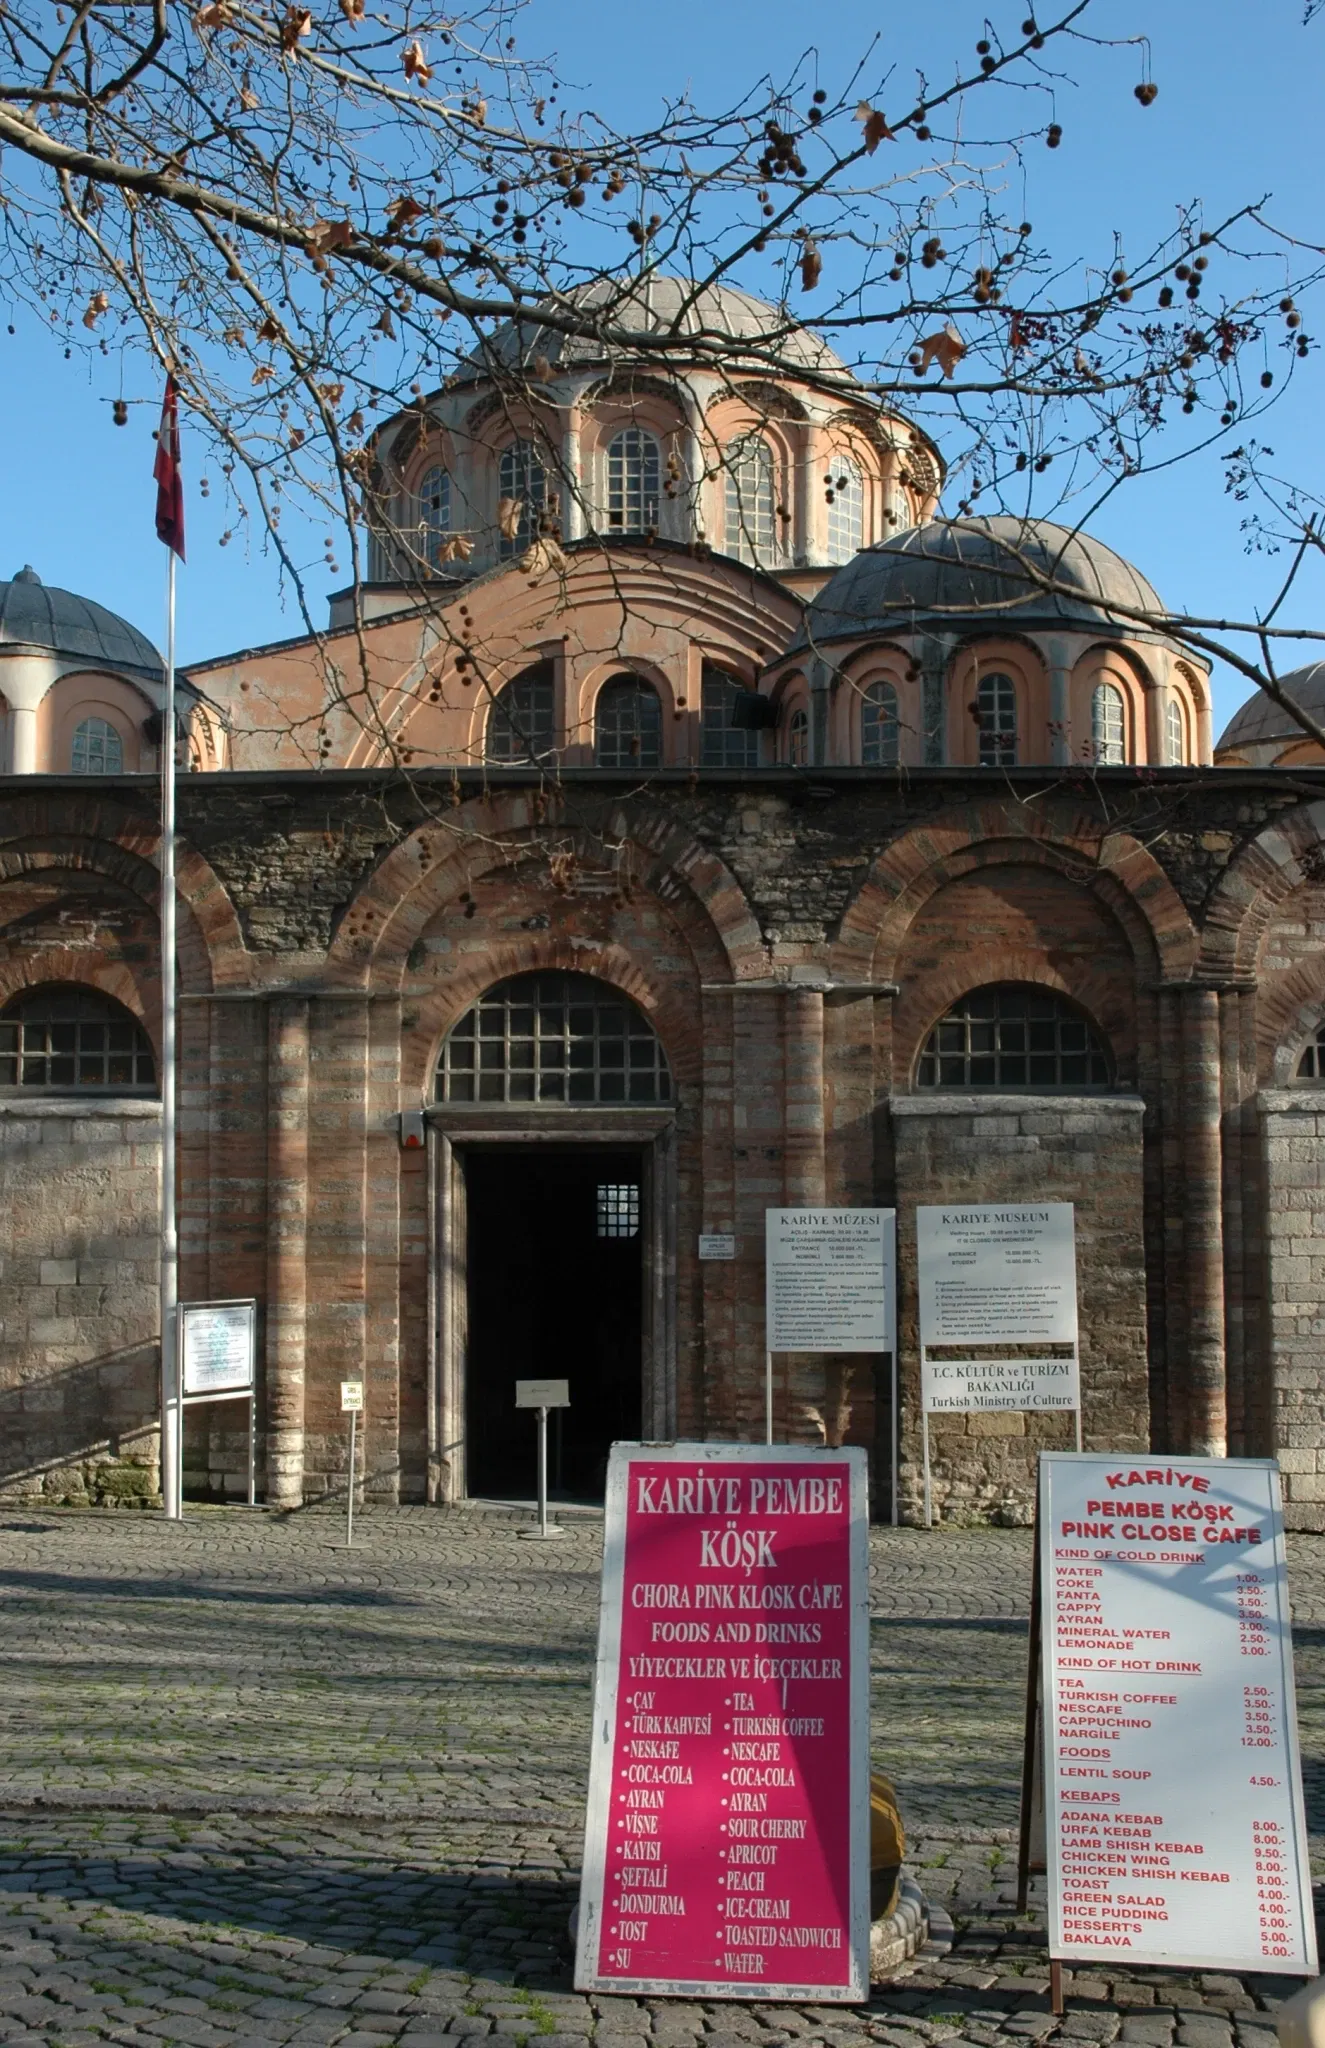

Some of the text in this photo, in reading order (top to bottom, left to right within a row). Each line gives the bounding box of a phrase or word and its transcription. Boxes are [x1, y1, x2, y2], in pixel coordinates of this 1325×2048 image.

[780, 1215, 880, 1225] KARİYE MÜZESİ
[942, 1212, 1049, 1224] KARIYE MUSEUM
[932, 1367, 953, 1378] T.C.
[957, 1364, 1004, 1377] KÜLTÜR
[1022, 1363, 1069, 1376] TURİZM
[967, 1379, 1034, 1392] BAKANLIĞI
[931, 1394, 1072, 1408] Turkish Ministry of Culture
[1105, 1467, 1211, 1493] KARİYE
[636, 1469, 842, 1514] KARİYE PEMBE
[1087, 1500, 1234, 1525] PEMBE KÖŞK
[1061, 1522, 1262, 1544] PINK CLOSE CAFE
[699, 1521, 777, 1576] KÖŞK
[1055, 1549, 1205, 1562] KIND OF COLD DRINK
[1056, 1567, 1103, 1577] WATER
[1056, 1579, 1094, 1588] COKE
[1237, 1586, 1267, 1595] 3.50.-
[632, 1585, 690, 1608] CHORA
[695, 1585, 734, 1608] PINK
[799, 1585, 842, 1609] CAFE
[1057, 1591, 1100, 1600] FANTA
[1238, 1598, 1268, 1607] 3.50.-
[1057, 1603, 1101, 1612] CAPPY
[1057, 1615, 1103, 1624] AYRAN
[652, 1623, 821, 1643] FOODS AND DRINKS
[1057, 1627, 1170, 1639] MINERAL WATER
[1058, 1639, 1134, 1650] LEMONADE
[629, 1654, 726, 1678] YİYECEKLER
[731, 1659, 750, 1678] VE
[1058, 1658, 1202, 1672] KIND OF HOT DRINK
[1058, 1679, 1084, 1688] TEA
[634, 1692, 655, 1713] ÇAY
[733, 1693, 754, 1711] TEA
[1058, 1691, 1177, 1704] TURKISH COFFEE
[1059, 1704, 1122, 1714] NESCAFE
[632, 1713, 711, 1735] TÜRK KAHVESİ
[732, 1718, 824, 1737] TURKISH COFFEE
[1059, 1716, 1152, 1729] CAPPUCHINO
[1059, 1728, 1120, 1740] NARGİLE
[630, 1741, 679, 1759] NESKAFE
[731, 1742, 780, 1761] NESCAFE
[1059, 1747, 1111, 1759] FOODS
[628, 1764, 693, 1784] COCA-COLA
[730, 1768, 795, 1787] COCA-COLA
[1060, 1767, 1152, 1780] LENTIL SOUP
[626, 1790, 664, 1809] AYRAN
[729, 1793, 766, 1812] AYRAN
[1060, 1790, 1120, 1802] KEBAPS
[625, 1811, 658, 1838] VİŞNE
[1061, 1812, 1163, 1825] ADANA KEBAB
[729, 1819, 807, 1839] SOUR CHERRY
[1061, 1825, 1152, 1837] URFA KEBAB
[623, 1841, 661, 1861] KAYISI
[1061, 1838, 1204, 1854] LAMB SHISH KEBAB
[727, 1845, 777, 1864] APRICOT
[1061, 1852, 1170, 1866] CHICKEN WING
[621, 1864, 667, 1891] ŞEFTALİ
[727, 1872, 765, 1891] PEACH
[1062, 1865, 1230, 1883] CHICKEN SHISH KEBAB
[1062, 1879, 1110, 1890] TOAST
[620, 1894, 685, 1916] DONDURMA
[1063, 1892, 1165, 1906] GREEN SALAD
[725, 1898, 790, 1919] ICE-CREAM
[1063, 1906, 1168, 1921] RICE PUDDING
[618, 1921, 648, 1941] TOST
[1064, 1919, 1142, 1933] DESSERT'S
[725, 1925, 841, 1948] TOASTED SANDWICH
[1064, 1933, 1132, 1947] BAKLAVA
[616, 1948, 631, 1969] SU
[724, 1954, 764, 1974] WATER
